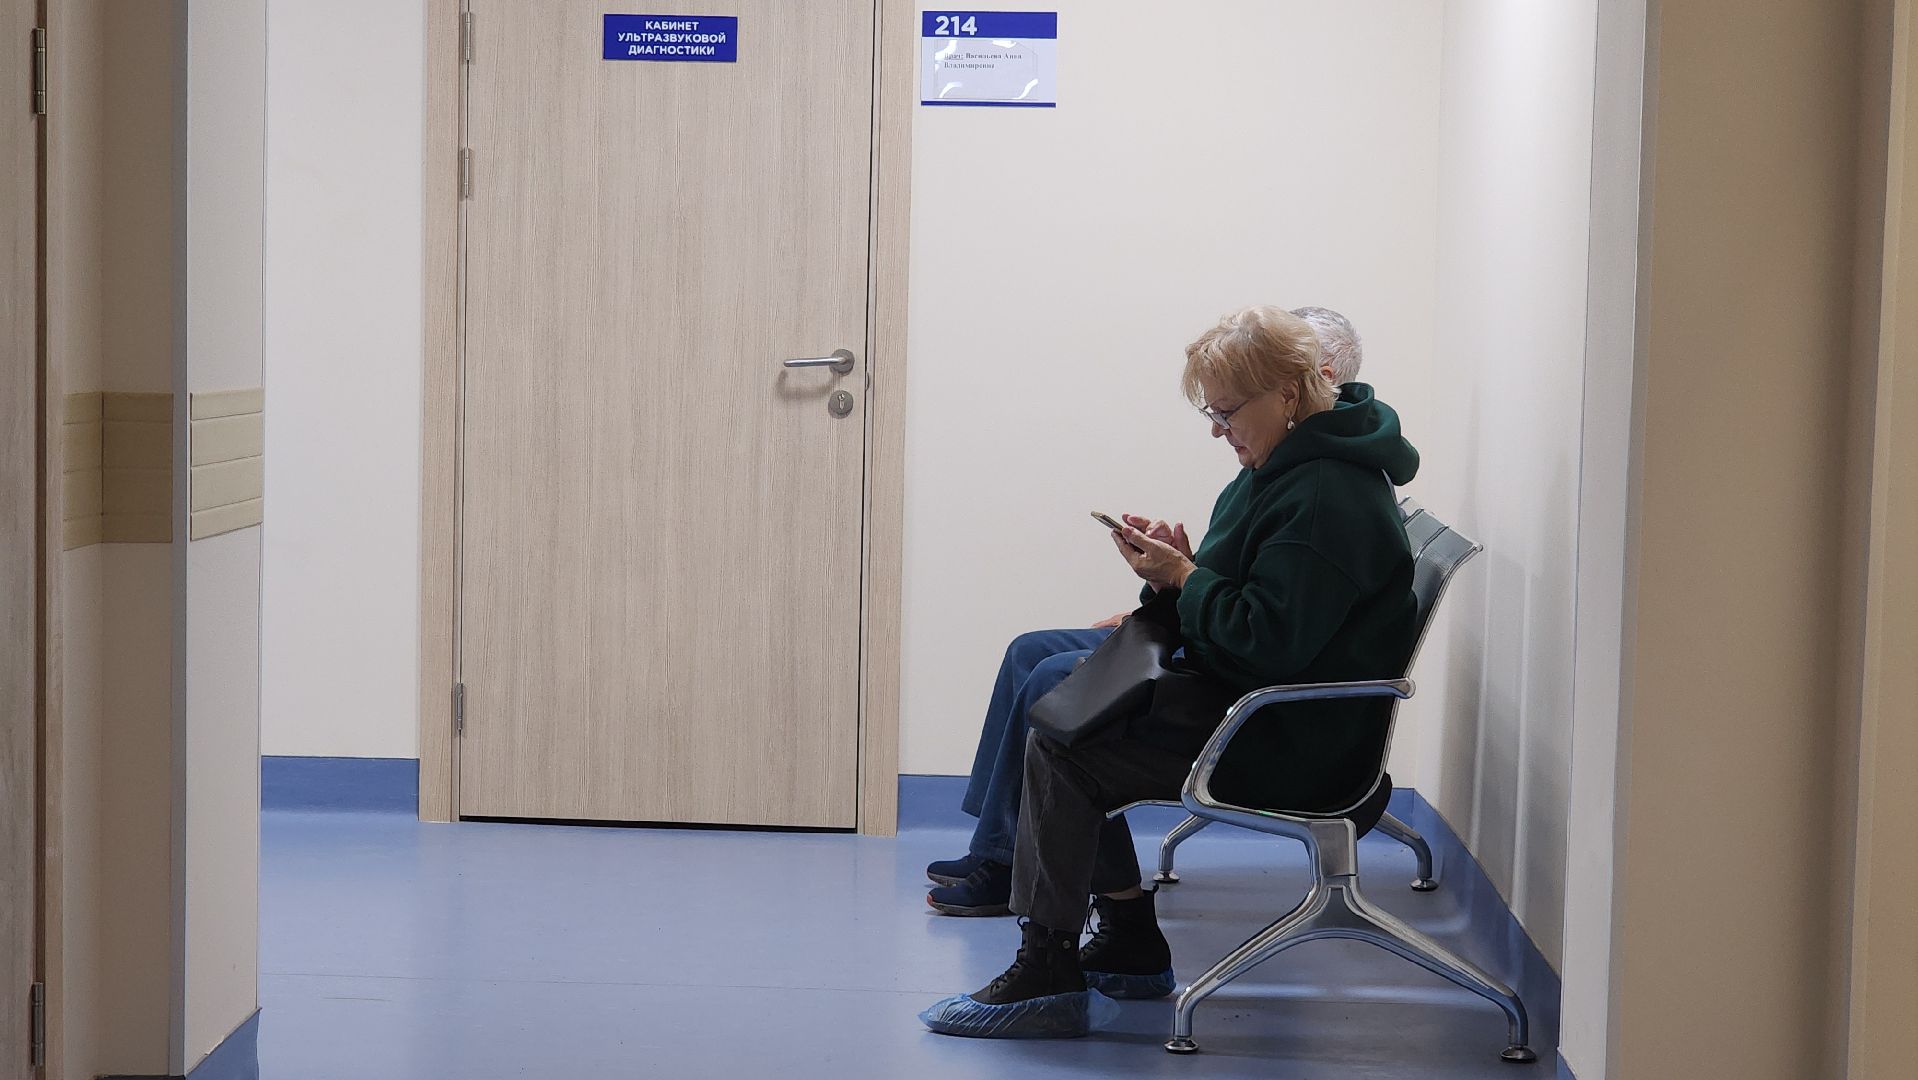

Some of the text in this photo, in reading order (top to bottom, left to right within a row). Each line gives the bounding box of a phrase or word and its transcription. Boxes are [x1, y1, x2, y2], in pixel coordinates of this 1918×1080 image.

[645, 21, 699, 31] КАБИНЕТ
[934, 15, 978, 36] 214
[617, 32, 726, 43] УЛЬТРАЗВУКОВОЙ
[628, 45, 715, 56] ДИАГНОСТИКИ
